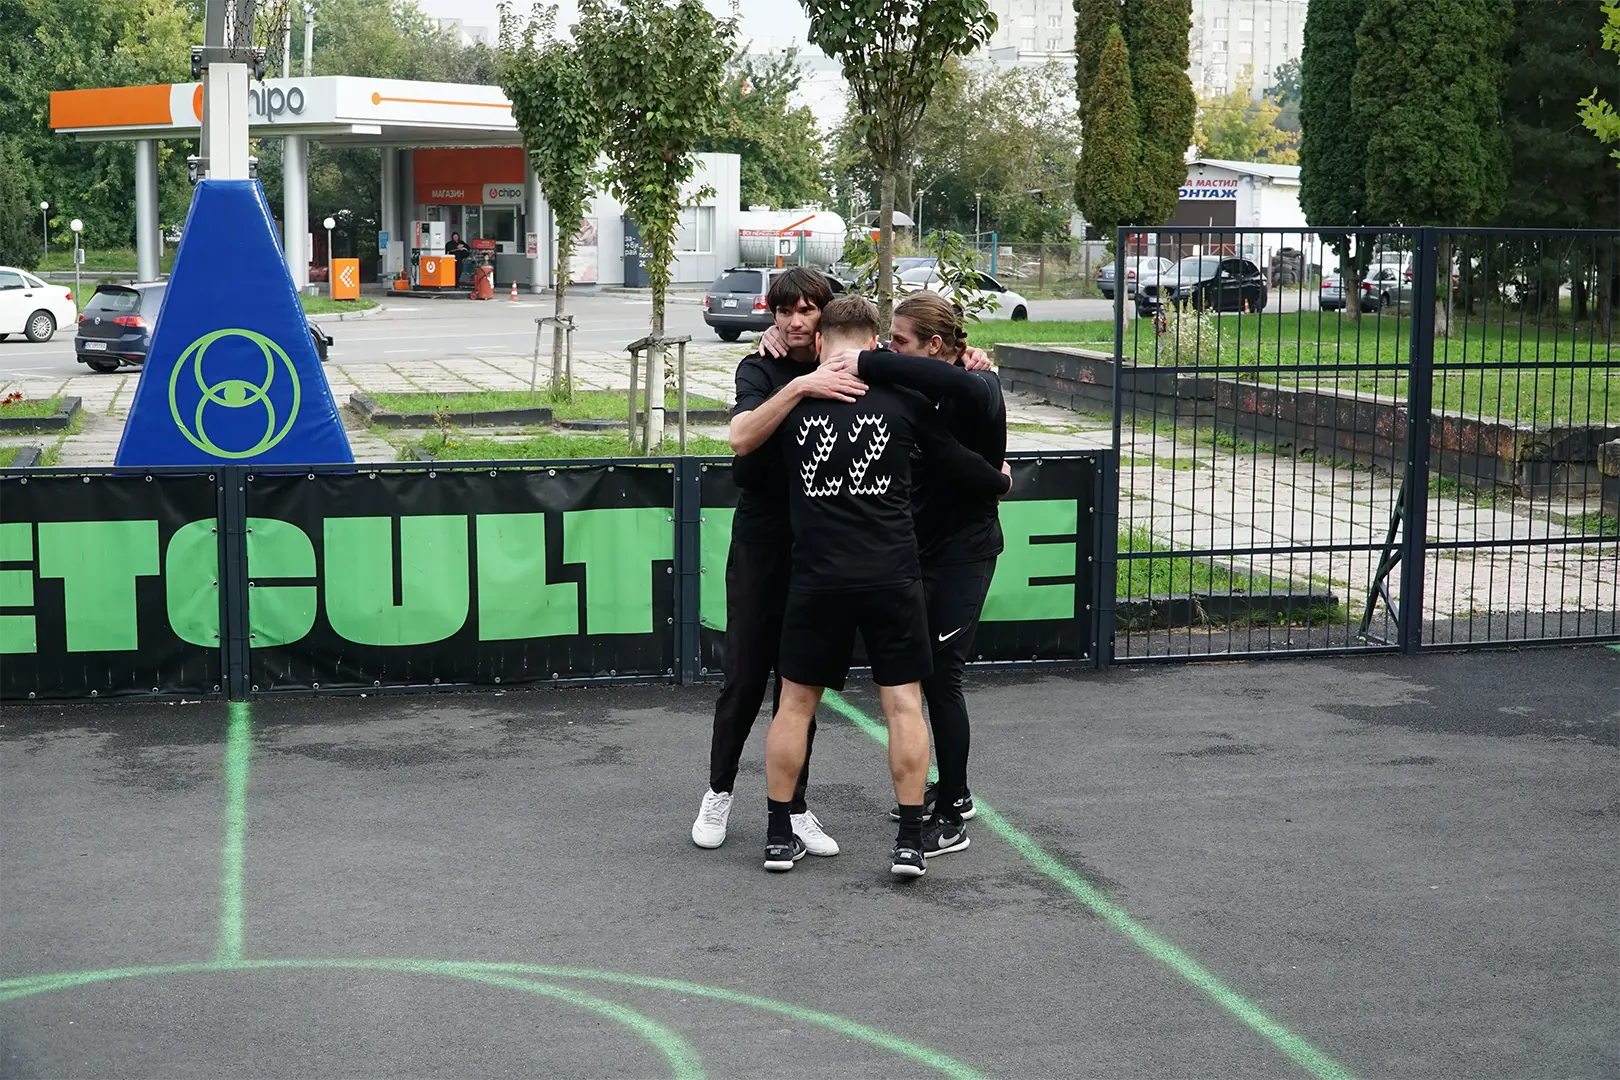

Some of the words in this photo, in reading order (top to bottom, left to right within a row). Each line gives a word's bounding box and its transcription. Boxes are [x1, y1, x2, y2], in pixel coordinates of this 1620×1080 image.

[432, 189, 464, 198] МАГАЗИН
[498, 188, 521, 199] chipo
[796, 413, 891, 498] 22
